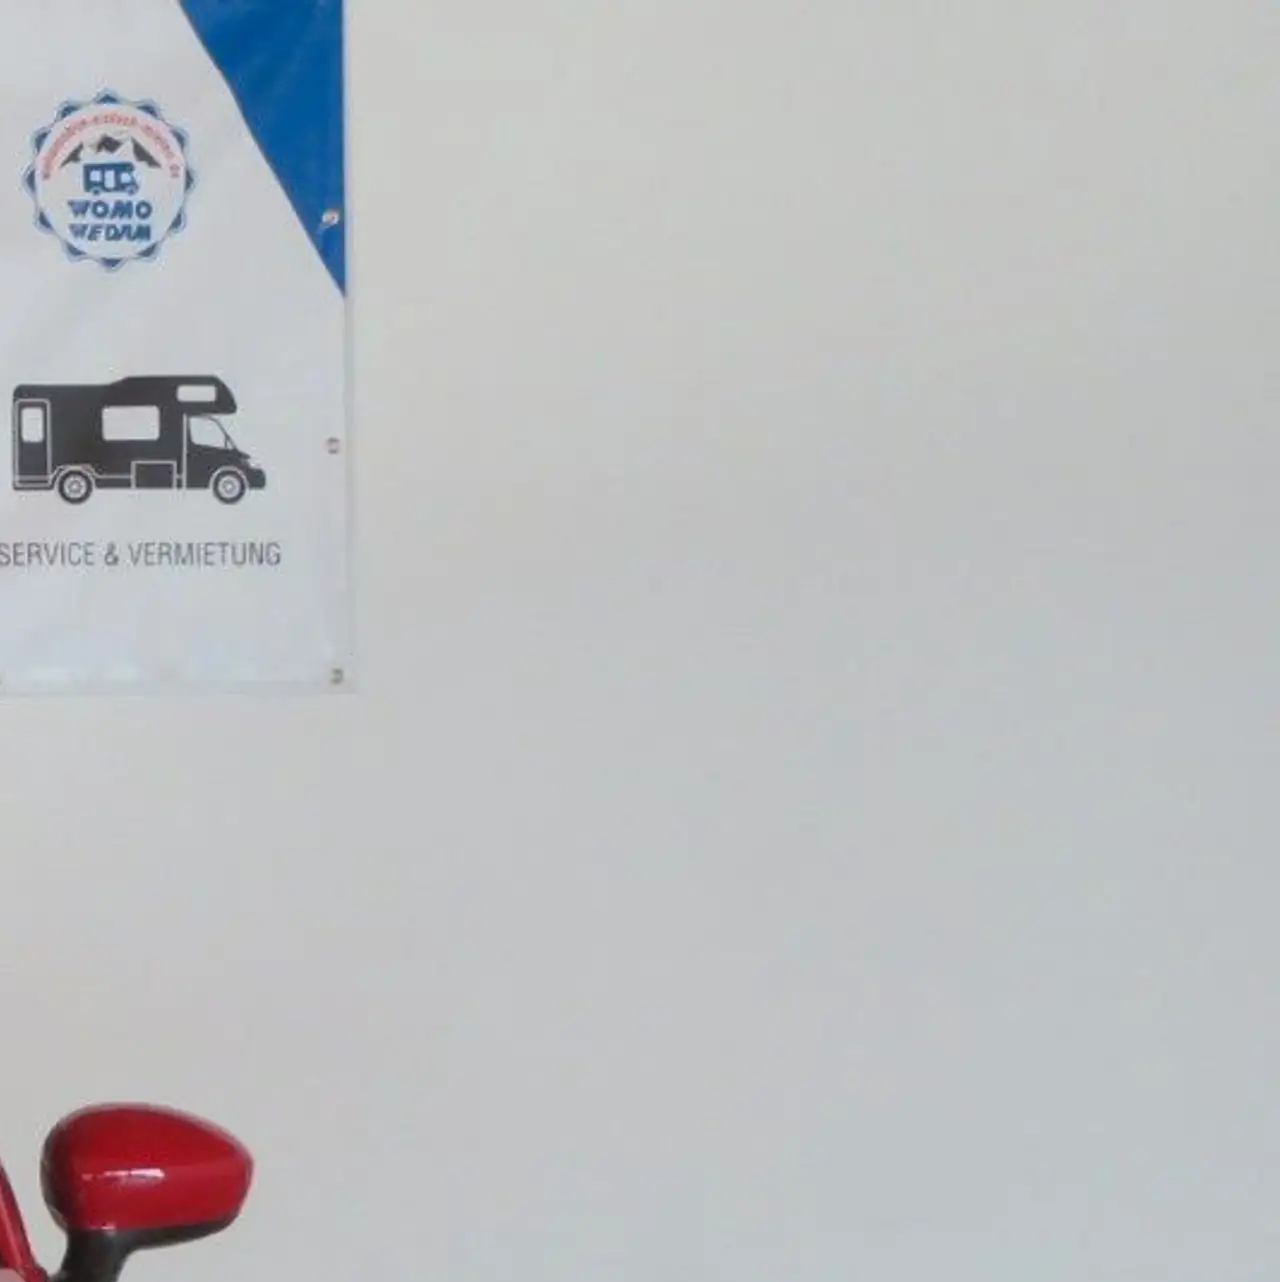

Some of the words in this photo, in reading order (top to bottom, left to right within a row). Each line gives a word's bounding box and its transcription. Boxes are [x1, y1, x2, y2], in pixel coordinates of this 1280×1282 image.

[67, 200, 154, 220] WOMO
[68, 223, 152, 242] WEDAM
[104, 543, 120, 566] &
[128, 541, 282, 567] VERMIETUNG
